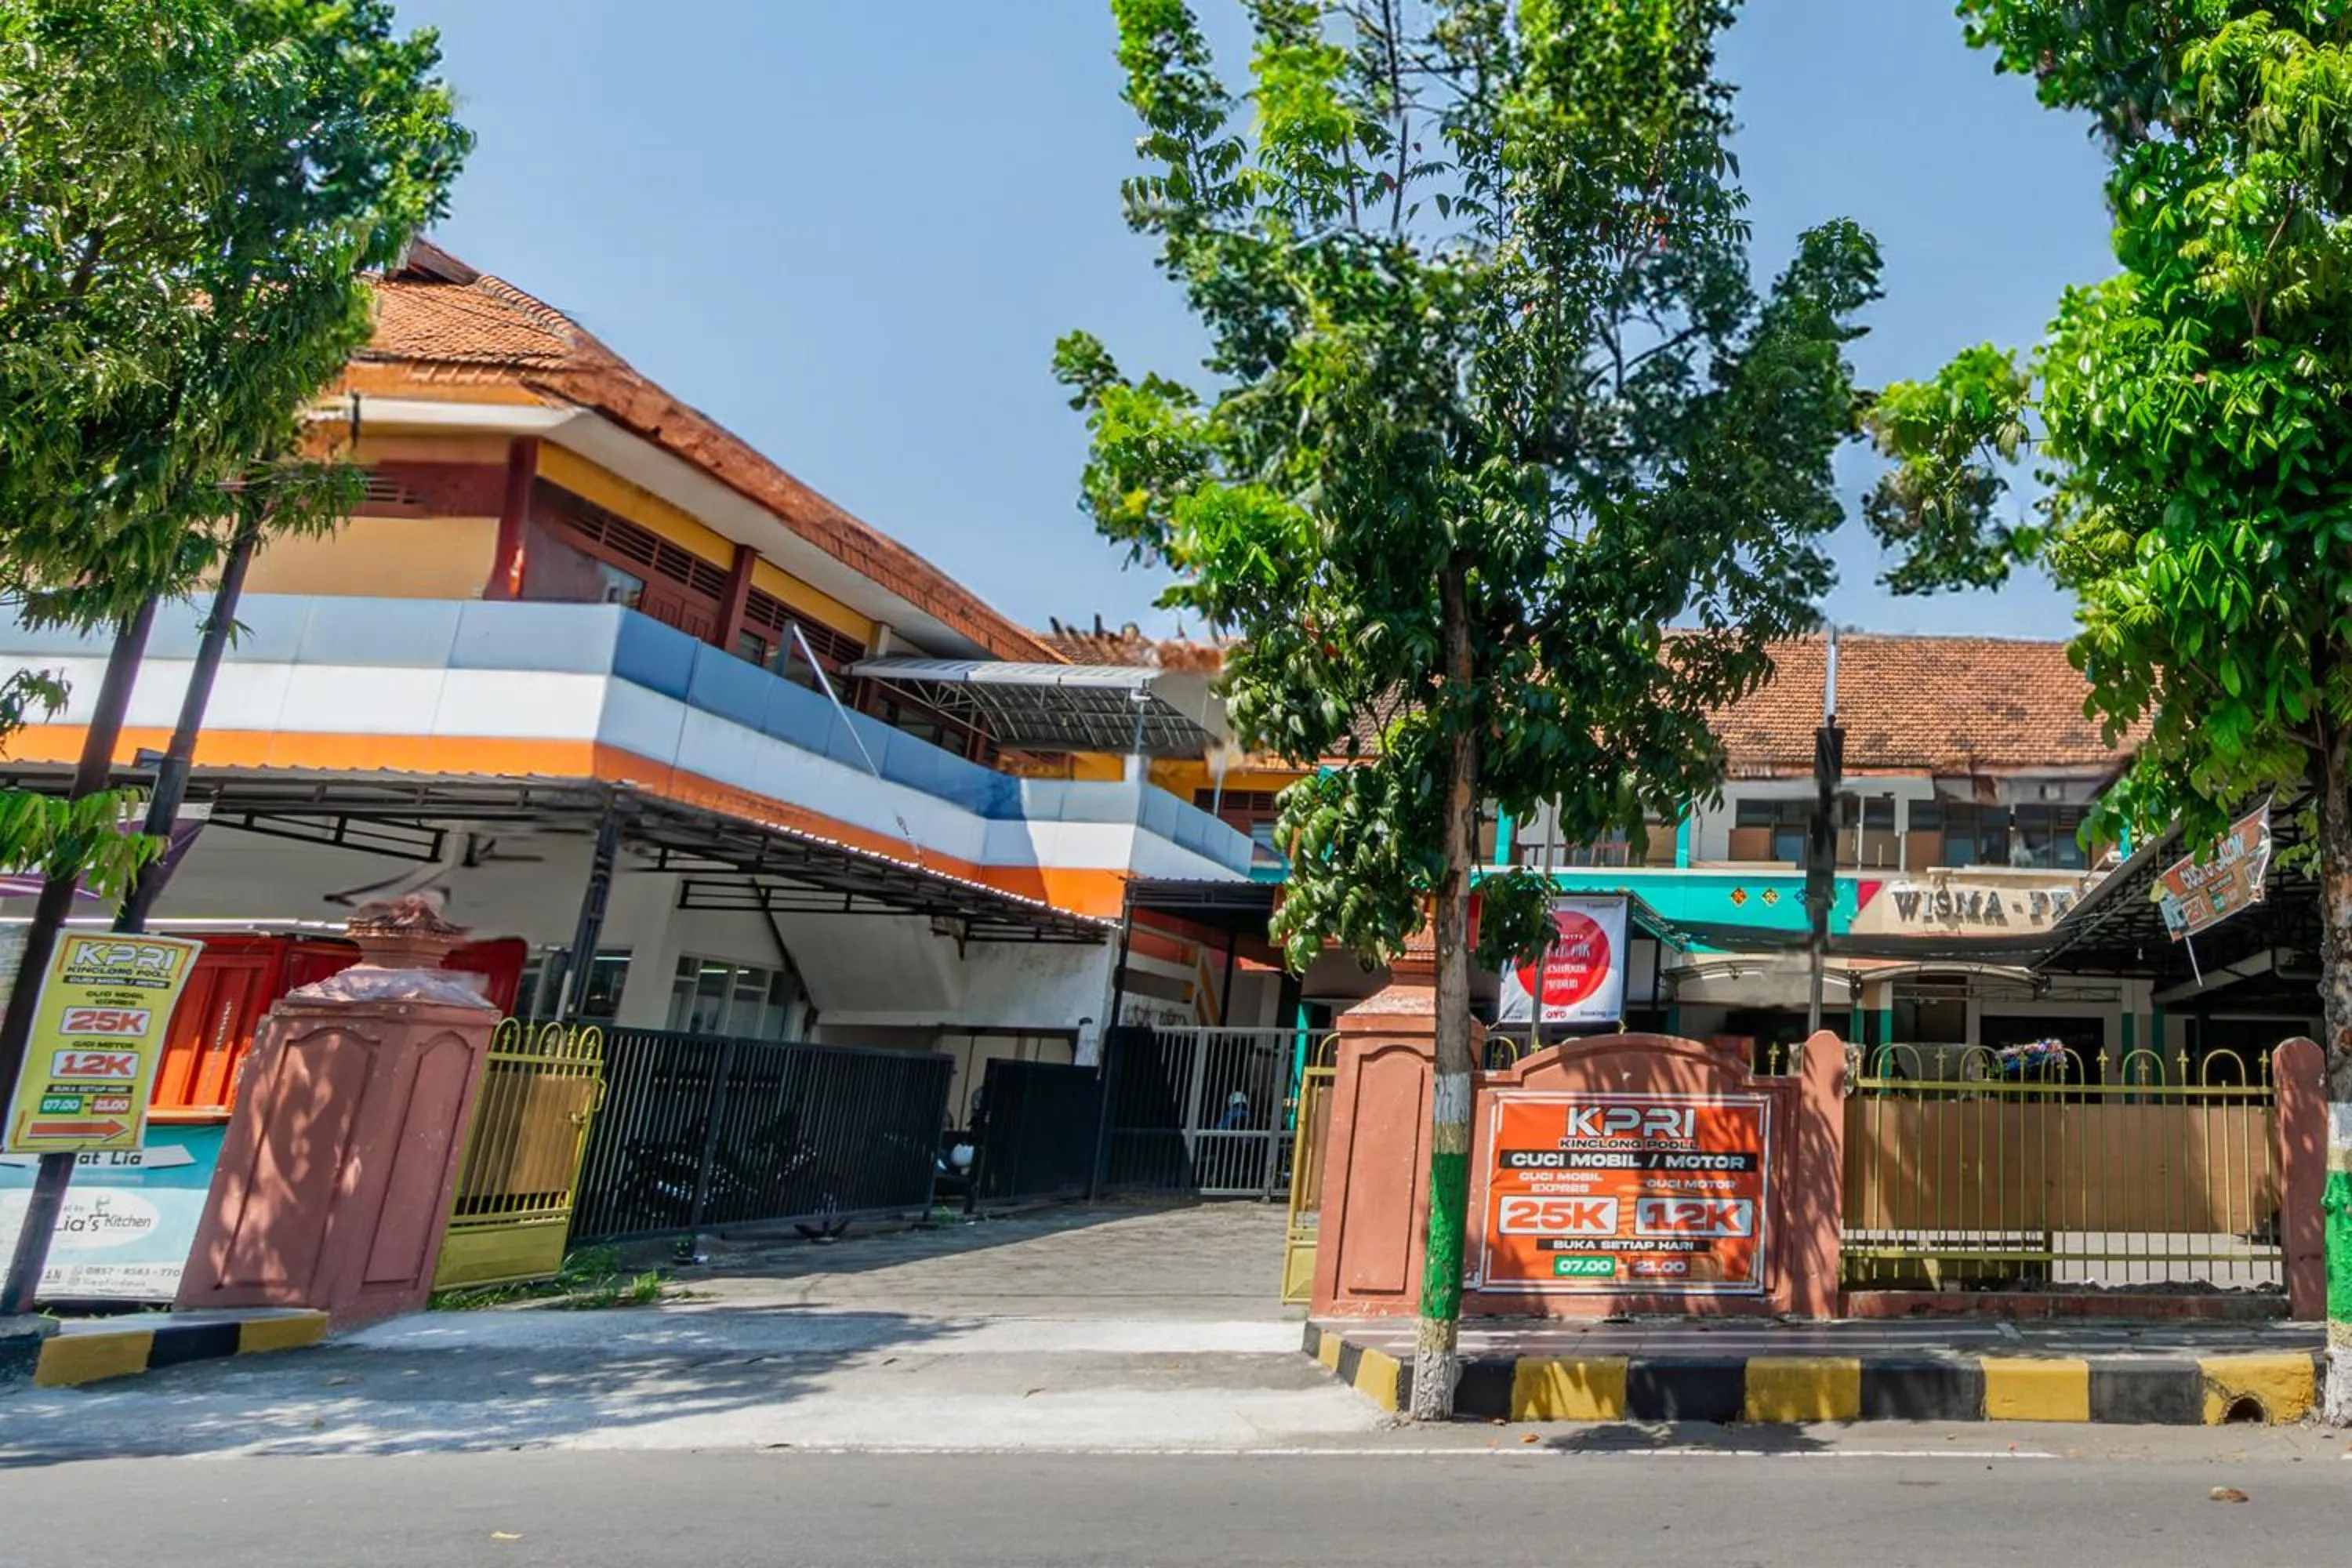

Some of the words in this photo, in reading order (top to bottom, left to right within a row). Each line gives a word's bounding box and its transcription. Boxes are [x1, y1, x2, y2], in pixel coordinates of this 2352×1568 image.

[1892, 890, 2008, 925] WISMA
[2029, 887, 2074, 926] PK
[74, 942, 178, 971] KPRI
[67, 1010, 147, 1033] 25K
[59, 1053, 134, 1076] 12K
[42, 1099, 79, 1110] 07.00
[1567, 1106, 1697, 1138] KPRI
[1559, 1138, 1642, 1149] KINCLONG
[1646, 1139, 1700, 1150] POOLL
[110, 1151, 143, 1166] Lia
[1510, 1152, 1565, 1167] CUCI
[1570, 1153, 1642, 1167] MOBIL
[1664, 1155, 1745, 1169] MOTOR
[1518, 1172, 1554, 1181] CUCI
[1556, 1173, 1603, 1182] MOBIL
[1646, 1179, 1682, 1189] CUCI
[1683, 1180, 1737, 1189] MOTOR
[1530, 1183, 1589, 1193] EXPRES
[104, 1214, 151, 1229] Kitchen
[1506, 1201, 1610, 1230] 25K
[1643, 1203, 1744, 1232] 12K
[1552, 1240, 1597, 1250] BUKA
[1600, 1240, 1655, 1250] SETIAP
[1658, 1240, 1695, 1251] HARI
[1558, 1260, 1612, 1272] 07.00
[1635, 1260, 1687, 1273] 21.00
